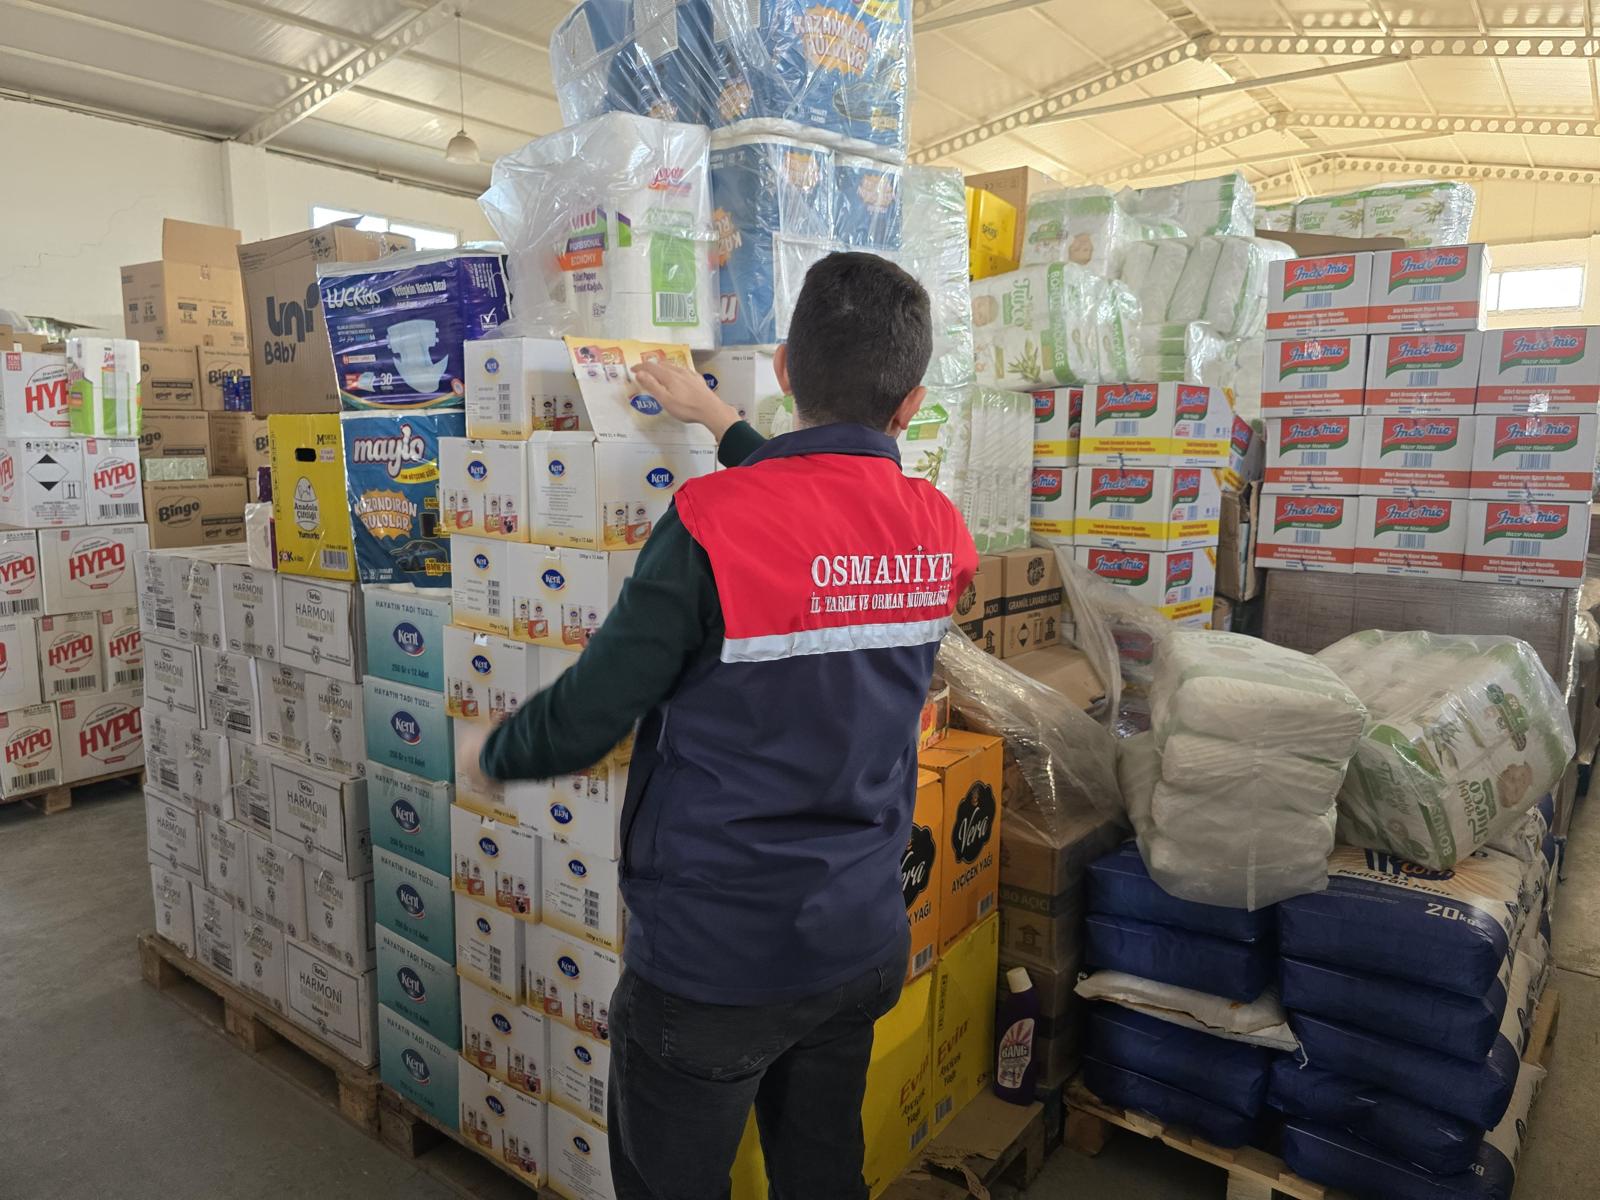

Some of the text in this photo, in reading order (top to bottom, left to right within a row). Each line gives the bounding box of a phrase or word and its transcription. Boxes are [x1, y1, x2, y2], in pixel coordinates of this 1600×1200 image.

[265, 341, 296, 365] Baby
[379, 373, 393, 385] 30
[25, 379, 68, 413] HYP
[94, 462, 136, 490] HYPO
[651, 473, 670, 484] Kent
[158, 502, 200, 521] Bingo
[354, 497, 418, 517] KAZANDIRAN
[362, 514, 409, 531] RULOLAR
[69, 543, 125, 580] HYPO
[811, 545, 953, 587] OSMANİYE
[545, 573, 562, 584] Kent
[295, 602, 335, 623] HARMONİ
[376, 600, 400, 611] HAYATIN
[402, 604, 416, 613] TADI
[824, 595, 856, 612] TARIM
[859, 596, 869, 610] VE
[871, 593, 904, 609] ORMAN
[109, 631, 141, 658] HYP
[397, 629, 418, 647] Kent
[48, 634, 93, 667] HYPO
[374, 687, 399, 699] HAYATIN
[399, 693, 413, 703] TADI
[79, 707, 143, 757] HYPO
[395, 717, 415, 734] Kent
[5, 728, 52, 763] HYPO
[375, 774, 413, 793] HAYATIN TADI
[287, 790, 328, 818] HARMONİ
[395, 805, 415, 824] Kent
[1468, 780, 1490, 844] Turco
[958, 807, 989, 853] Vera
[1430, 803, 1453, 857] BONUS
[381, 856, 404, 872] HAYATIN
[405, 867, 418, 879] TADI
[901, 851, 926, 892] era
[400, 889, 419, 908] Kent
[1425, 902, 1479, 926] 20kg
[383, 937, 419, 962] HAYATIN TADI
[560, 959, 577, 974] Kent
[299, 972, 343, 1003] HARMONİ
[400, 972, 420, 993] Kent
[387, 1018, 425, 1046] HAYATIN TADI
[494, 1017, 508, 1030] Kent
[1001, 1044, 1029, 1059] BANG
[405, 1053, 425, 1075] Kent
